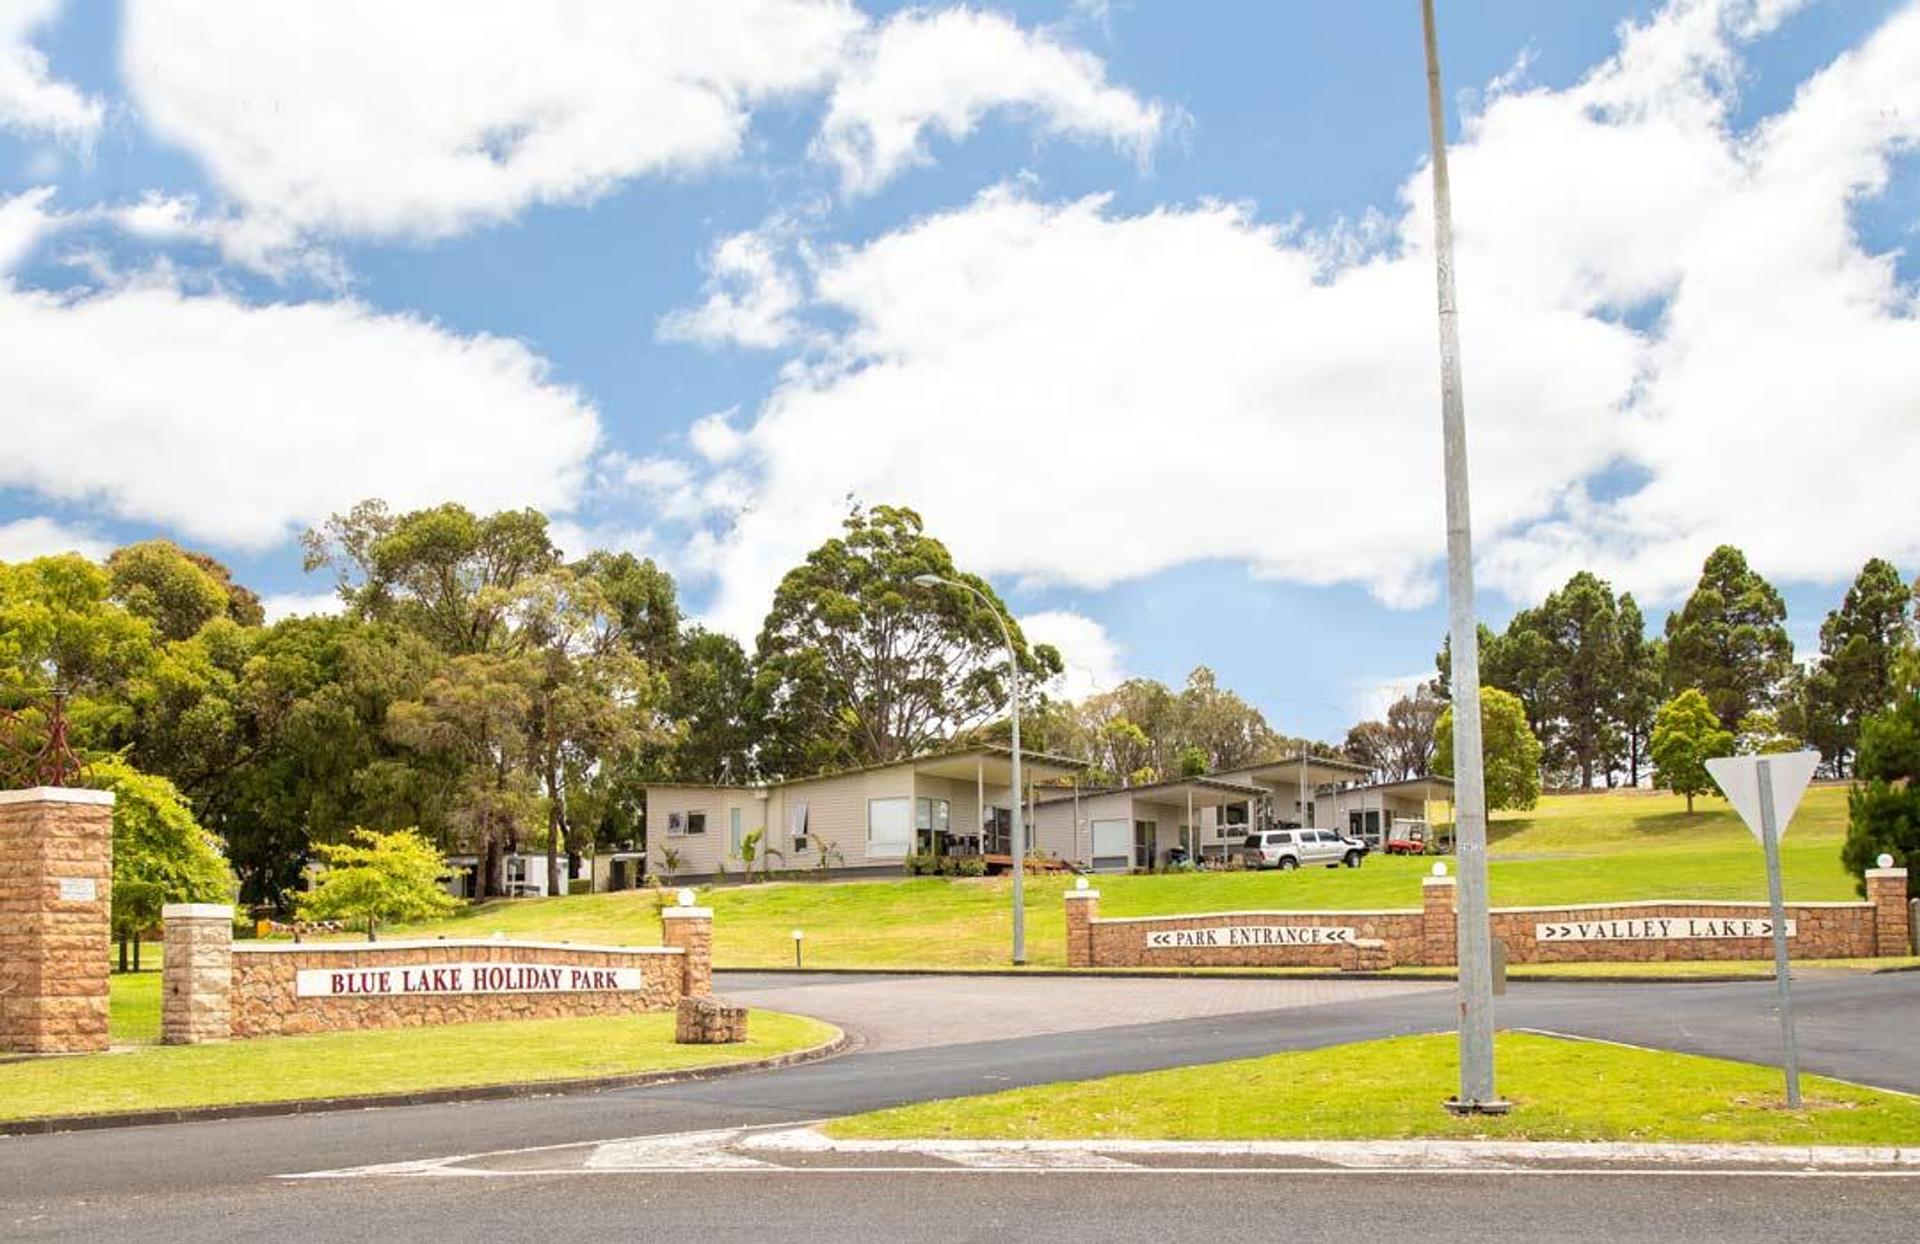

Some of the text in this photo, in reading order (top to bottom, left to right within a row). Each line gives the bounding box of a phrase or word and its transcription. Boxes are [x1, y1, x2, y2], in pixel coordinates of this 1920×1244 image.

[1176, 927, 1321, 945] PARK ENTRANCE
[1578, 920, 1755, 938] VALLEY LAKE
[331, 967, 618, 994] BLUE LAKE HOLIDAY PARK
